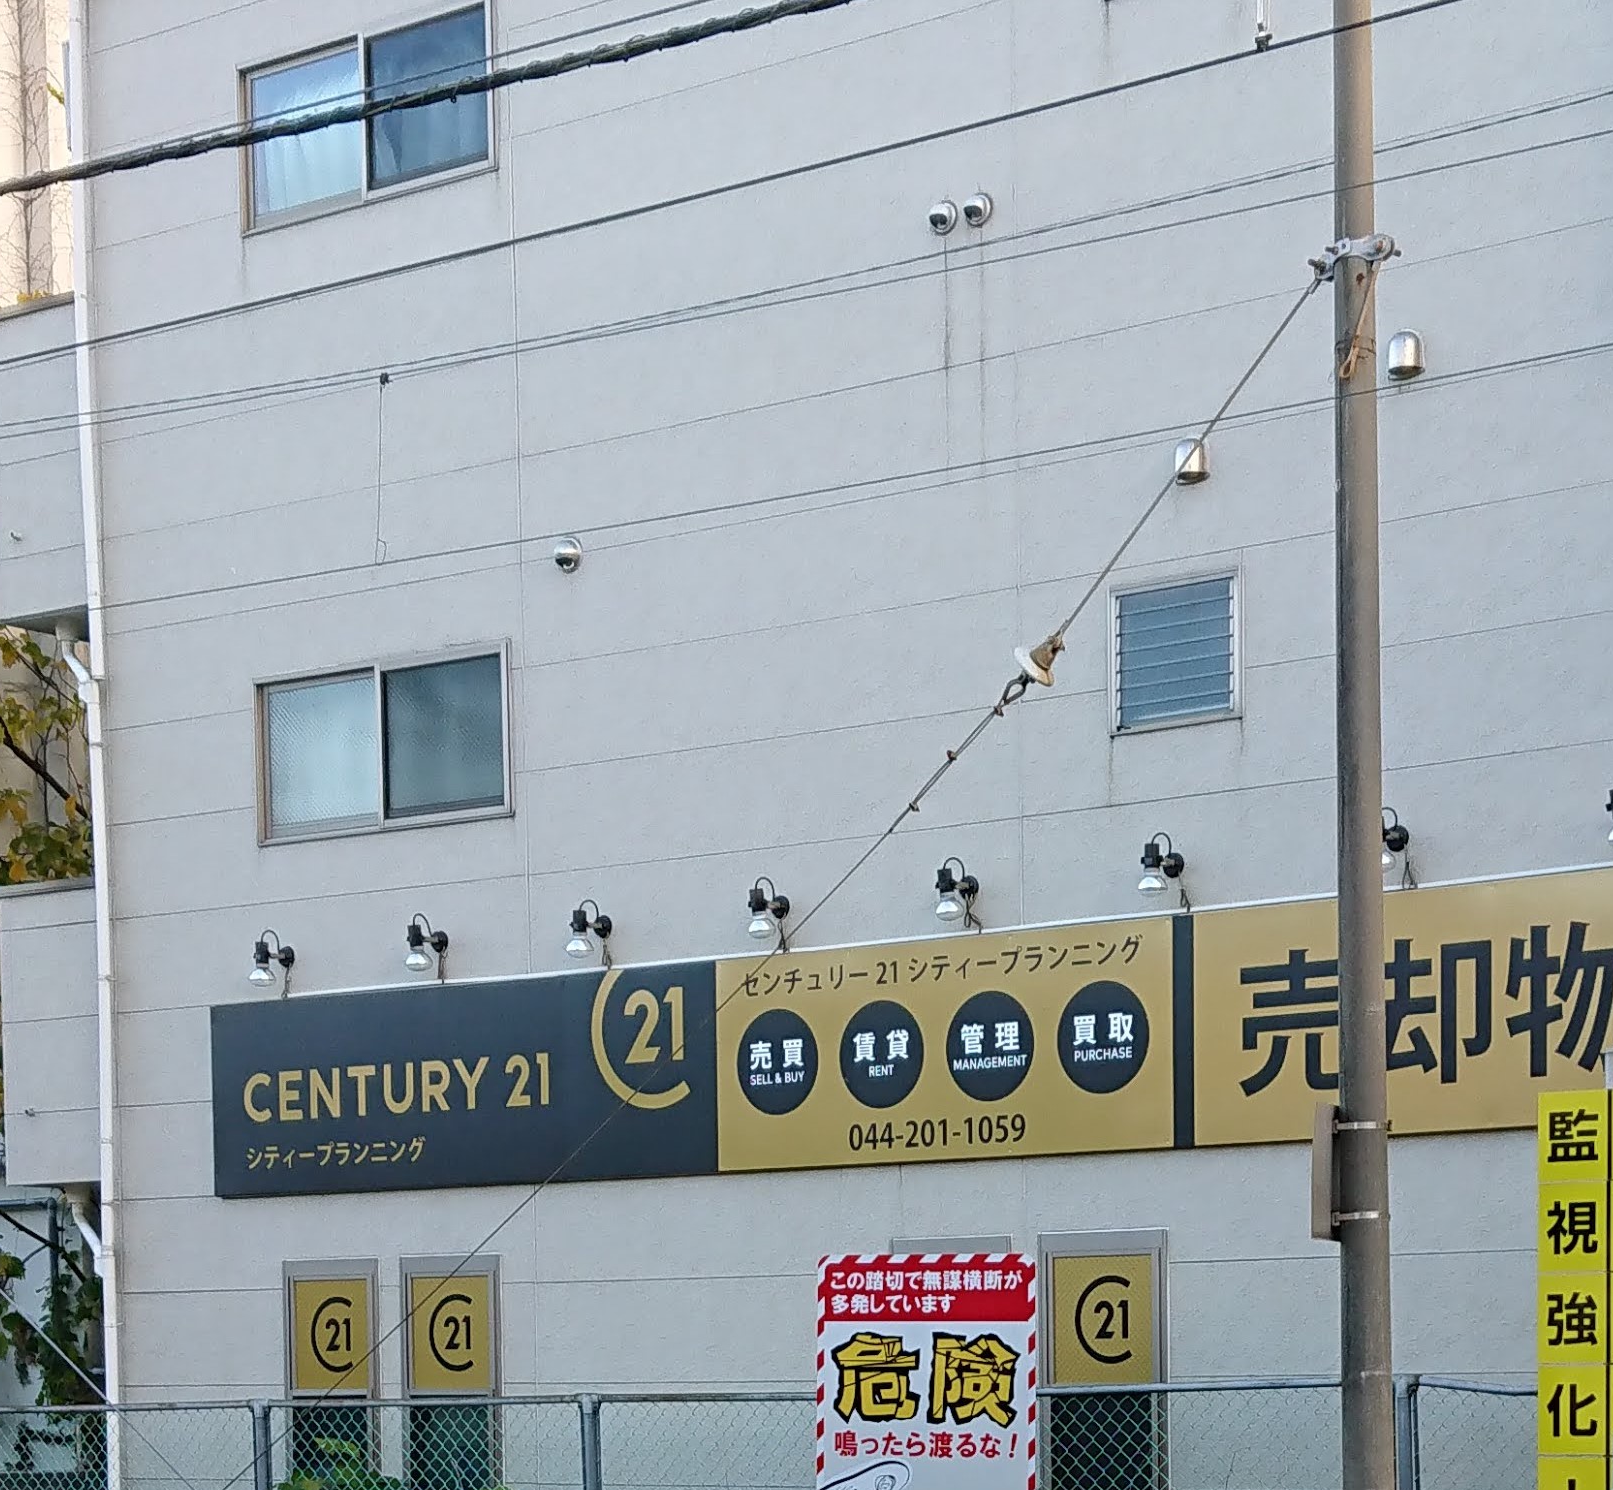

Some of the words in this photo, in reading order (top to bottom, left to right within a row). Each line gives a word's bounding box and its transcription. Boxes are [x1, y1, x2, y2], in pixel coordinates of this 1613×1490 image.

[741, 962, 869, 998] センチュリー
[875, 961, 900, 985] 21
[907, 933, 1144, 984] シティープランニング
[959, 1020, 1021, 1054] 管理
[1072, 1011, 1135, 1047] 買取
[748, 1038, 805, 1070] 売買
[852, 1028, 910, 1064] 賃貸
[1073, 1046, 1134, 1063] PURCHASE
[748, 1073, 774, 1086] SELL
[784, 1071, 805, 1084] BUY
[868, 1064, 895, 1078] RENT
[952, 1054, 1028, 1072] MANAGEMENT
[243, 1055, 490, 1124] CENTURY
[504, 1051, 550, 1108] 21
[848, 1113, 1027, 1152] 044-201-1059
[245, 1134, 427, 1171] シティープランニング
[830, 1269, 1023, 1291] この踏切で無謀横断が
[830, 1294, 957, 1315] 多発しています
[830, 1331, 1022, 1429] 危険
[833, 1431, 1020, 1460] 鳴ったら渡るな!
